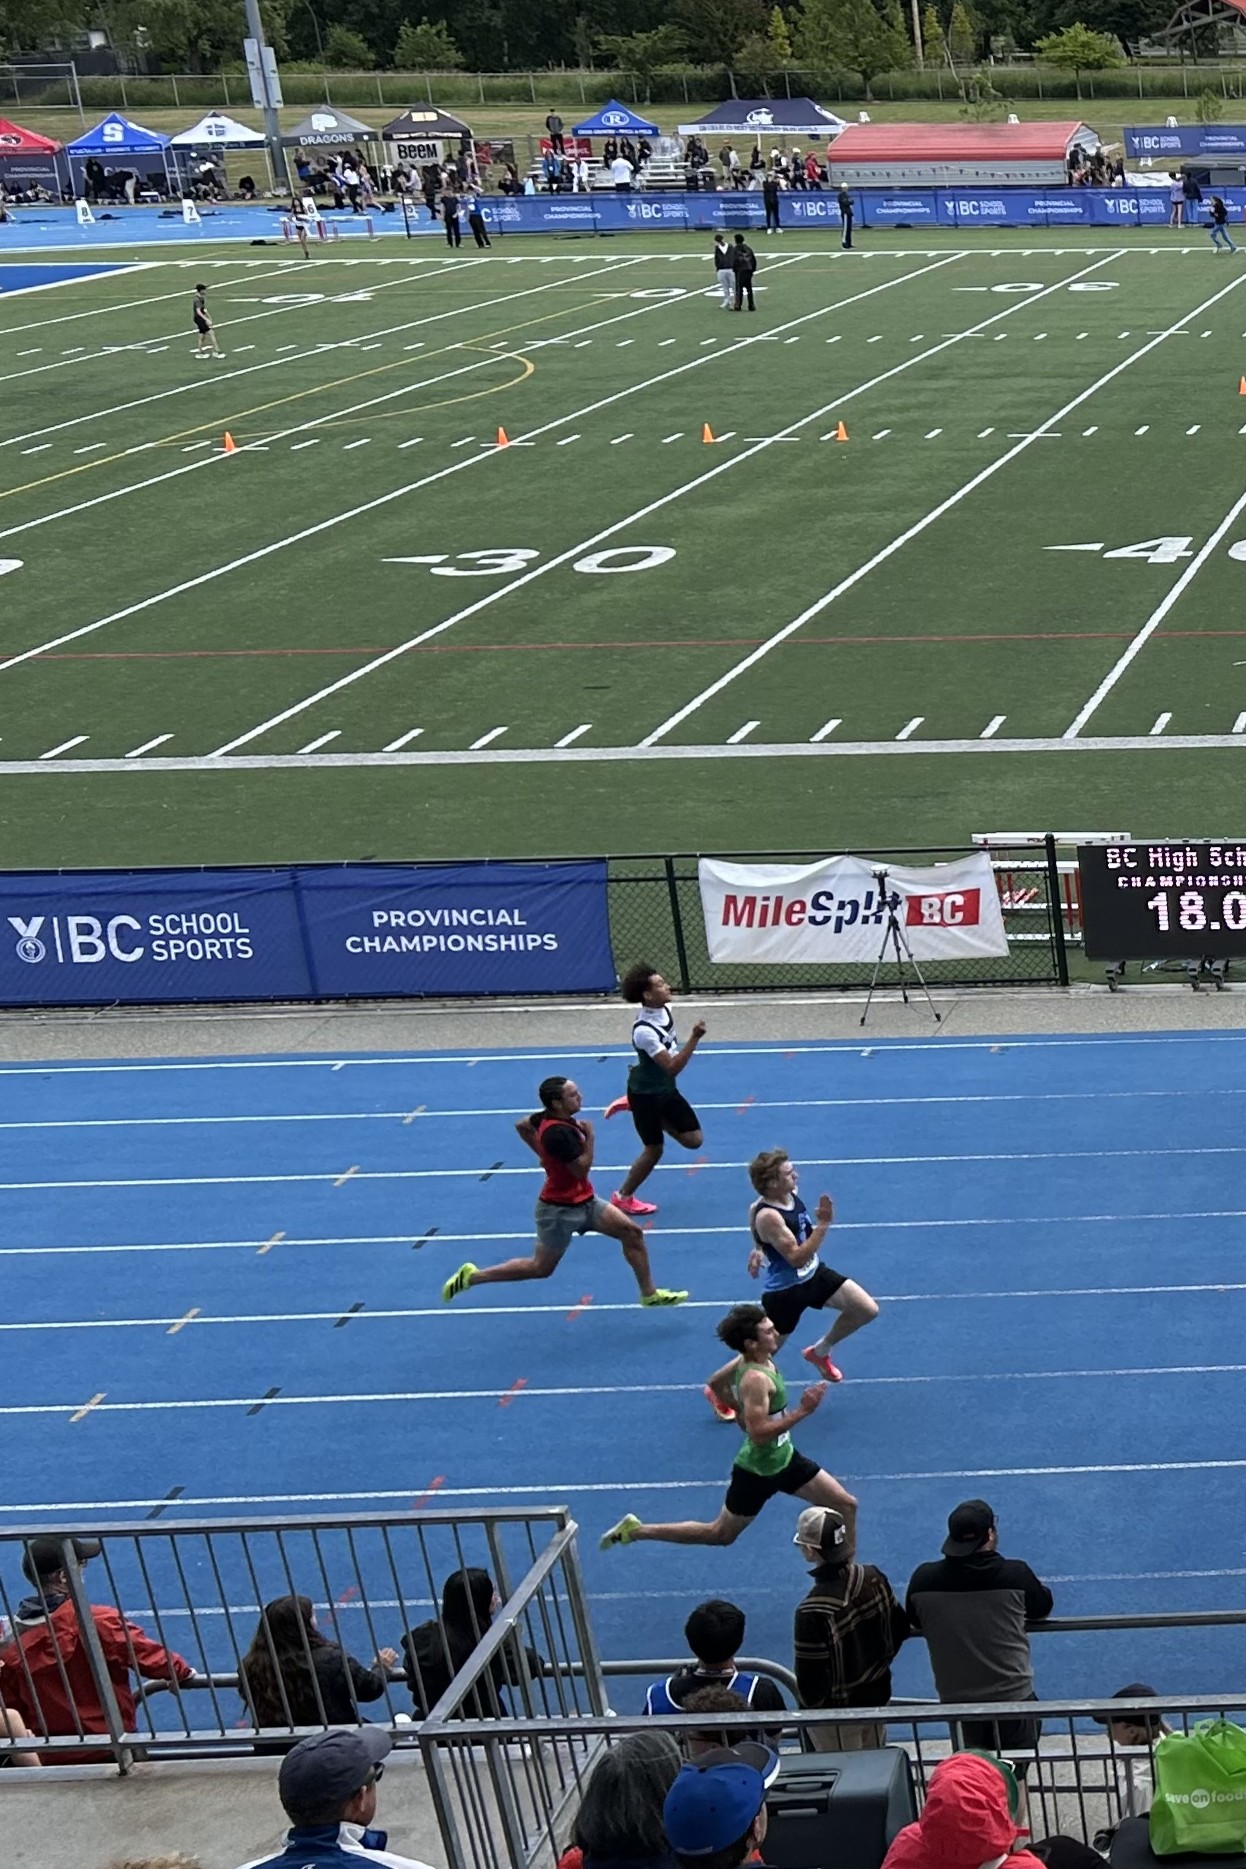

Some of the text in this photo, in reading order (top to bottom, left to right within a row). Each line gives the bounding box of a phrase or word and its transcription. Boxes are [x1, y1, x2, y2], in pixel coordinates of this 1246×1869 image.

[102, 122, 125, 143] S
[299, 133, 355, 146] DRAGONS
[1143, 136, 1160, 149] BC
[642, 204, 661, 218] BC
[807, 202, 826, 215] BC
[960, 201, 979, 215] BC
[1120, 199, 1138, 213] BC
[481, 209, 493, 222] C
[1106, 847, 1138, 869] BC
[1148, 846, 1199, 872] High
[921, 894, 965, 925] BC
[372, 908, 527, 928] PROVINCIAL
[67, 912, 250, 963] BC SCHOOL
[345, 933, 559, 953] CHAMPIONSHIPS
[151, 937, 254, 962] SPORTS
[1193, 1794, 1208, 1802] on
